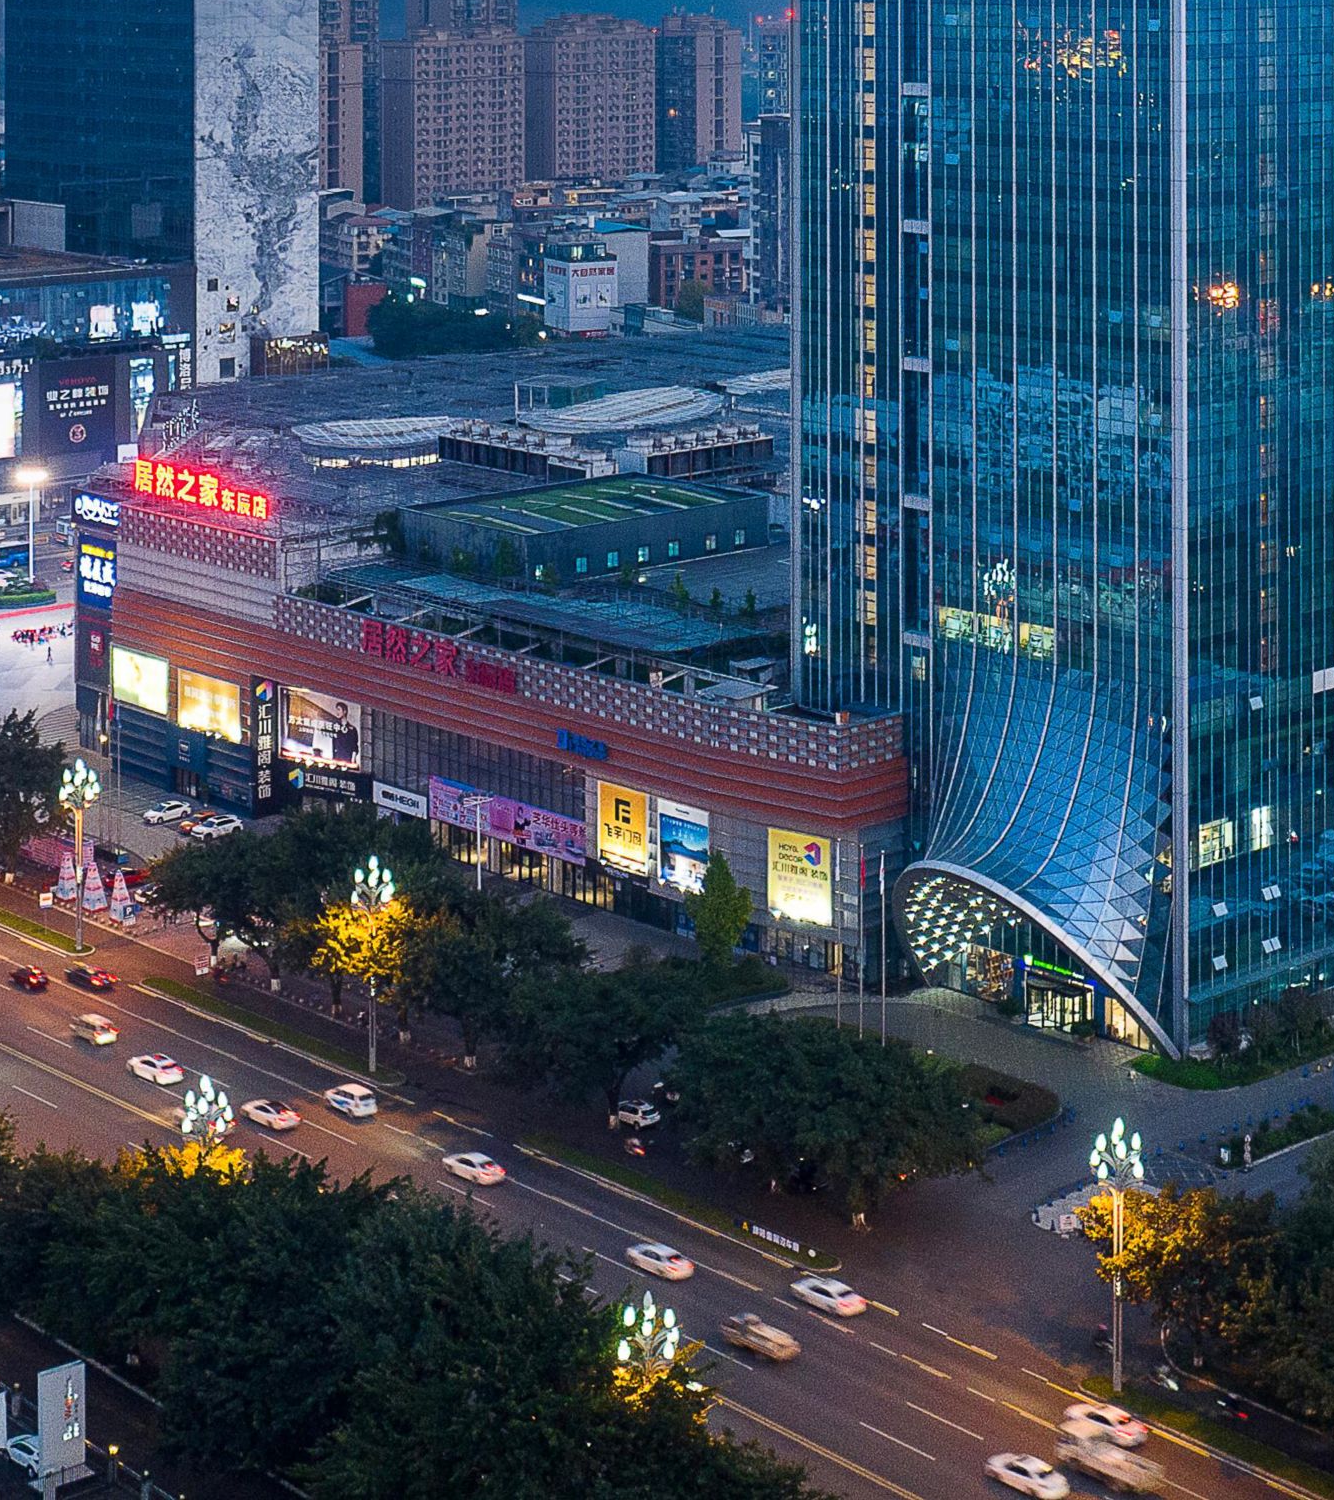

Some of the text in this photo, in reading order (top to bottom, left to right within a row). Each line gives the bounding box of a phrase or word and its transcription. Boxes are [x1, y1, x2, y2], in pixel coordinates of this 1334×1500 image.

[133, 458, 267, 520] 居然之家 东辰店
[360, 618, 460, 678] 居然之家
